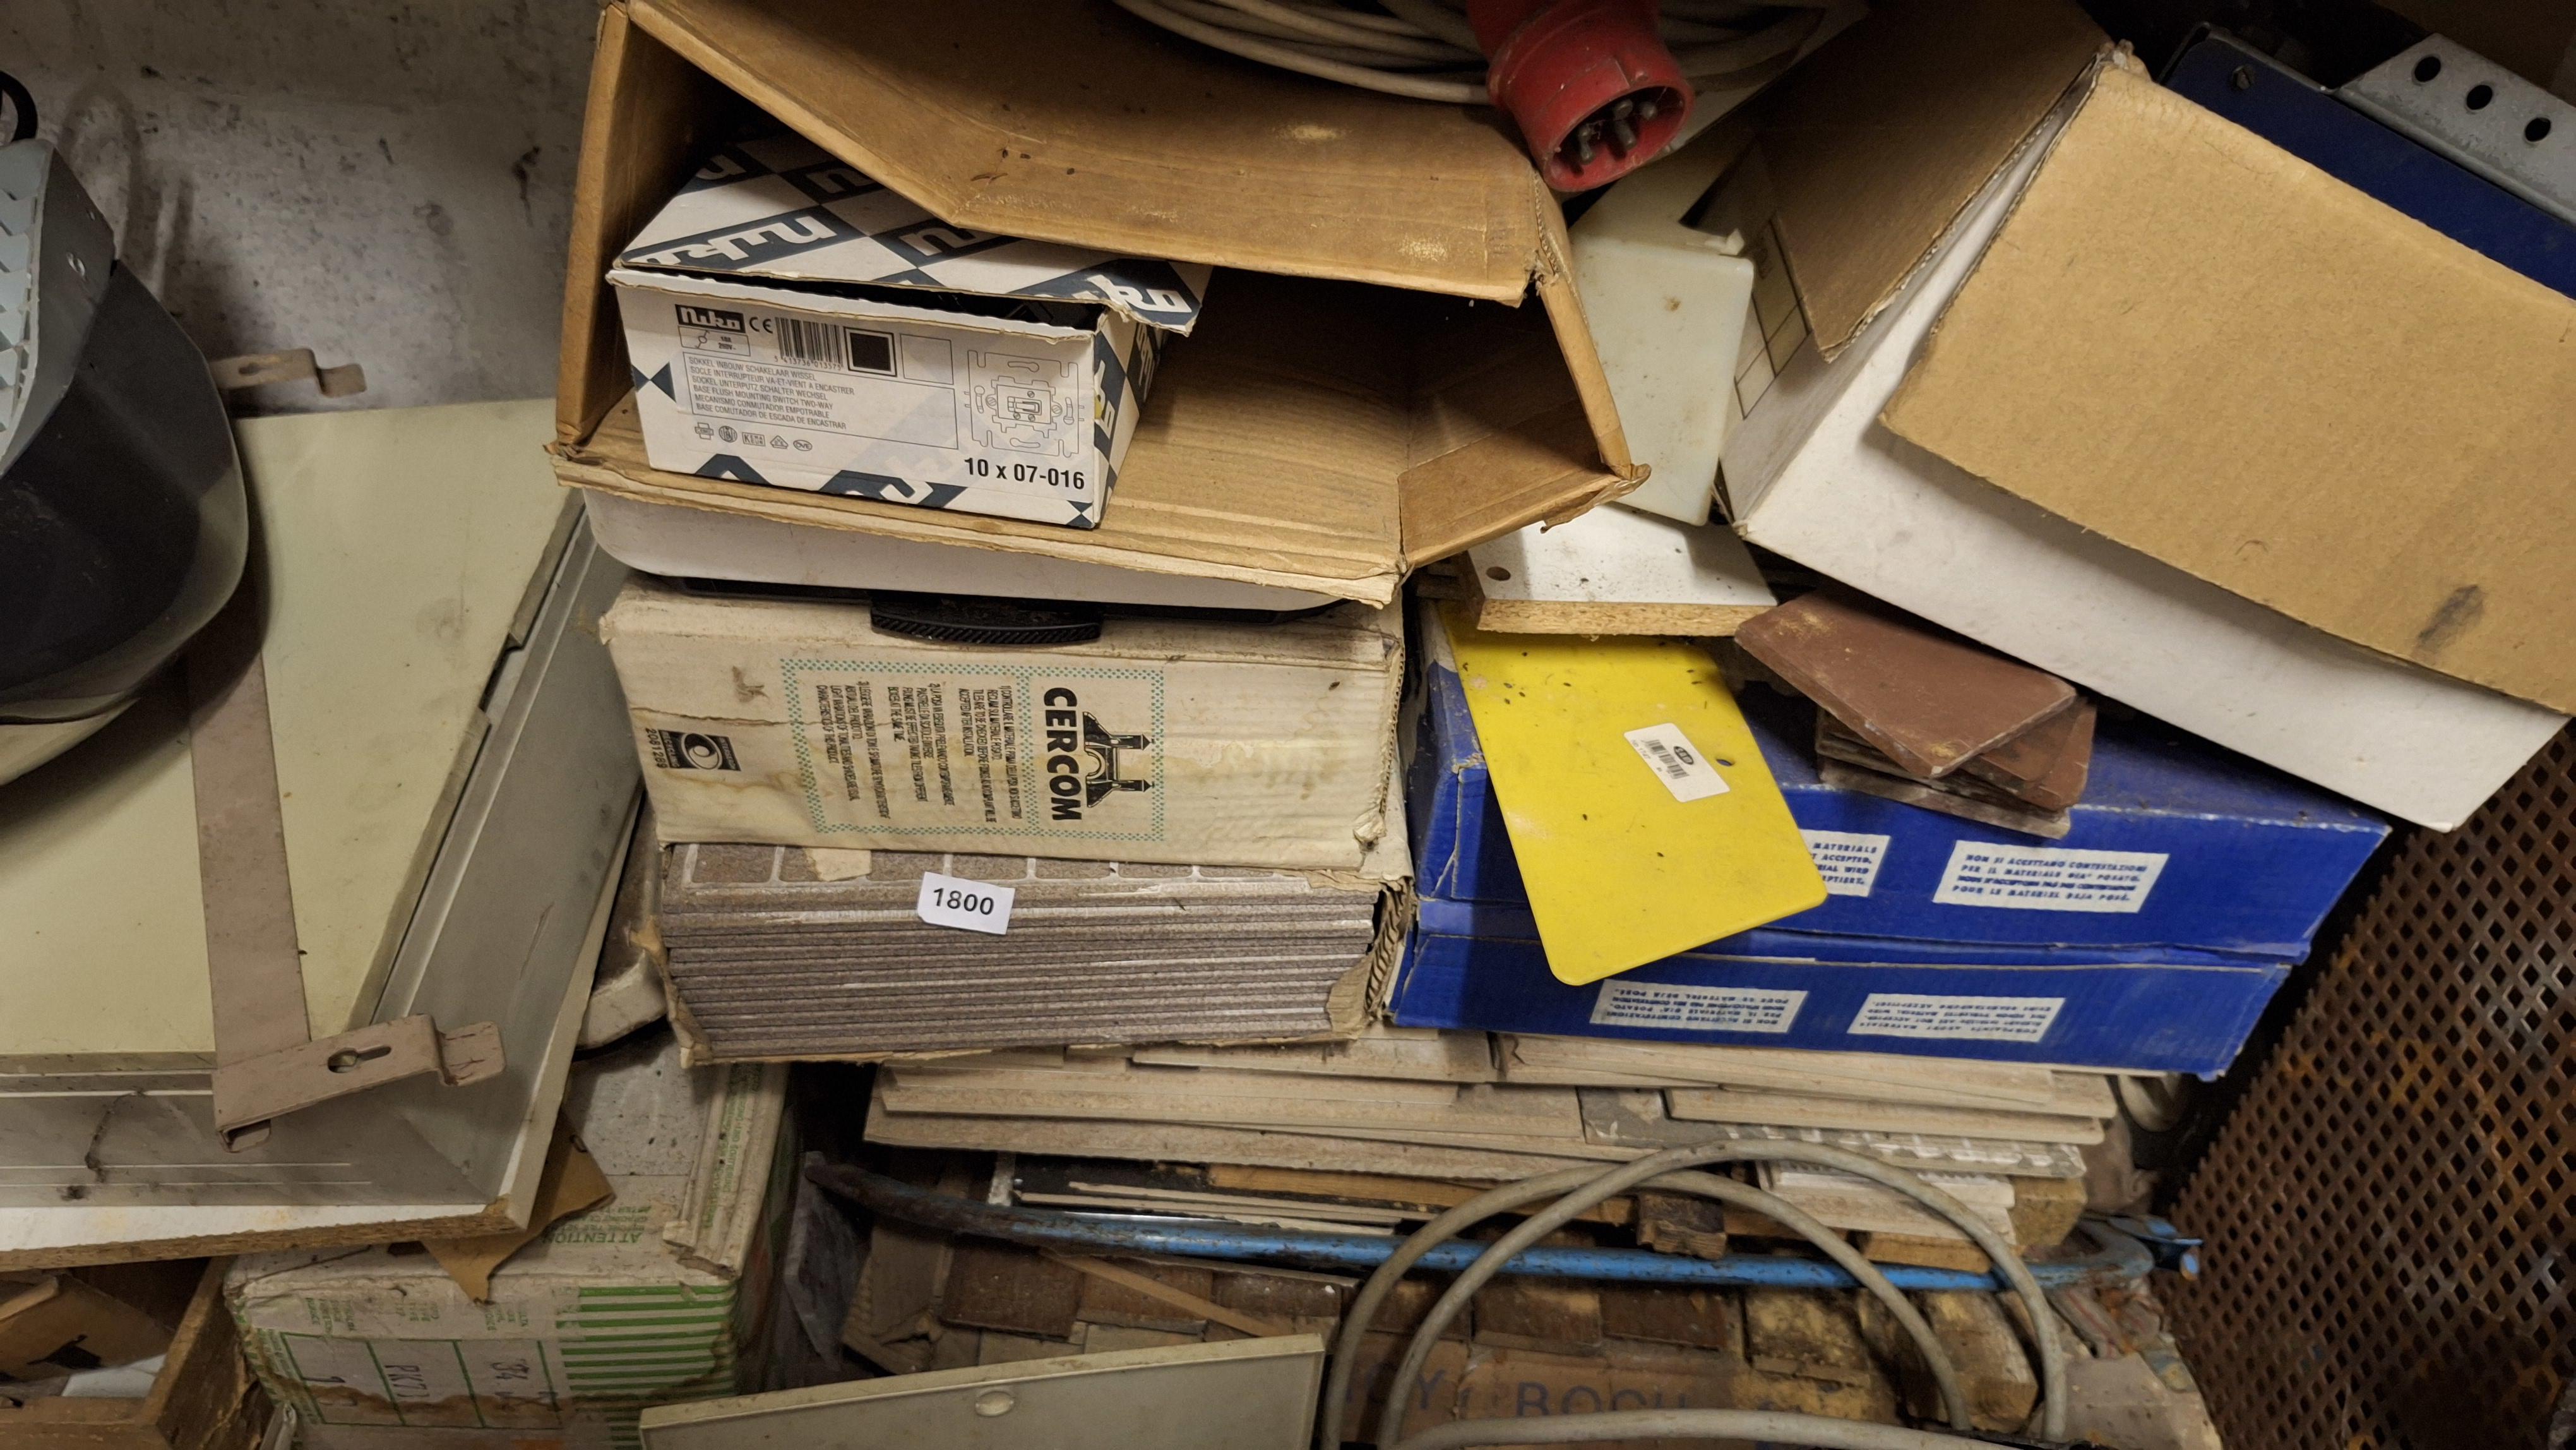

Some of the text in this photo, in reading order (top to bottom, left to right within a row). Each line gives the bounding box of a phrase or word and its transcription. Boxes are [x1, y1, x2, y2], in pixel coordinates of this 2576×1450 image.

[689, 356, 816, 381] SOKKEL INBOUW SCHAKELAAR WISSEL
[690, 365, 711, 375] SOCLE
[713, 368, 764, 383] INTERRUPTEUR
[766, 376, 806, 389] VA-ET-VIENT
[814, 383, 854, 395] ENCASTRER
[691, 375, 828, 401] SOCKEL UNTERPUTZ SCHALTER WECHSEL
[693, 384, 833, 410] BASE FLUSH MOUNTING SWITCH TWO-WAY
[694, 393, 829, 419] MECANISMO CONMUTADOR EMPOTRABLE
[696, 403, 713, 412] BASE
[715, 405, 757, 417] COMUTADOR
[769, 413, 795, 422] ESCADA
[807, 418, 846, 429] ENCASTRAR
[964, 457, 1085, 489] 10 x 07-016
[830, 685, 843, 698] LIGHT
[888, 686, 900, 701] BOXES
[915, 688, 929, 713] PIASTRELLE
[930, 695, 942, 705] POSA
[958, 688, 971, 710] ACCEPTED
[903, 702, 915, 714] MUST
[1001, 690, 1013, 721] CONTROLLARE
[891, 717, 903, 728] SAME
[960, 712, 972, 725] AFTER
[660, 731, 679, 768] RECYCLING
[1044, 686, 1082, 822] CERCOM
[1813, 842, 1877, 853] MATERIALS
[1960, 865, 1981, 873] PER
[2004, 868, 2062, 878] MATERIALE
[1964, 854, 1990, 863] NON
[2007, 857, 2066, 868] ACCETTANO
[2068, 861, 2148, 872] CONTESTAZIONI
[933, 887, 994, 915] 1800
[1951, 885, 1984, 894] POUR
[2007, 889, 2061, 898] MATERIEL
[541, 1228, 641, 1245] ATTENTION
